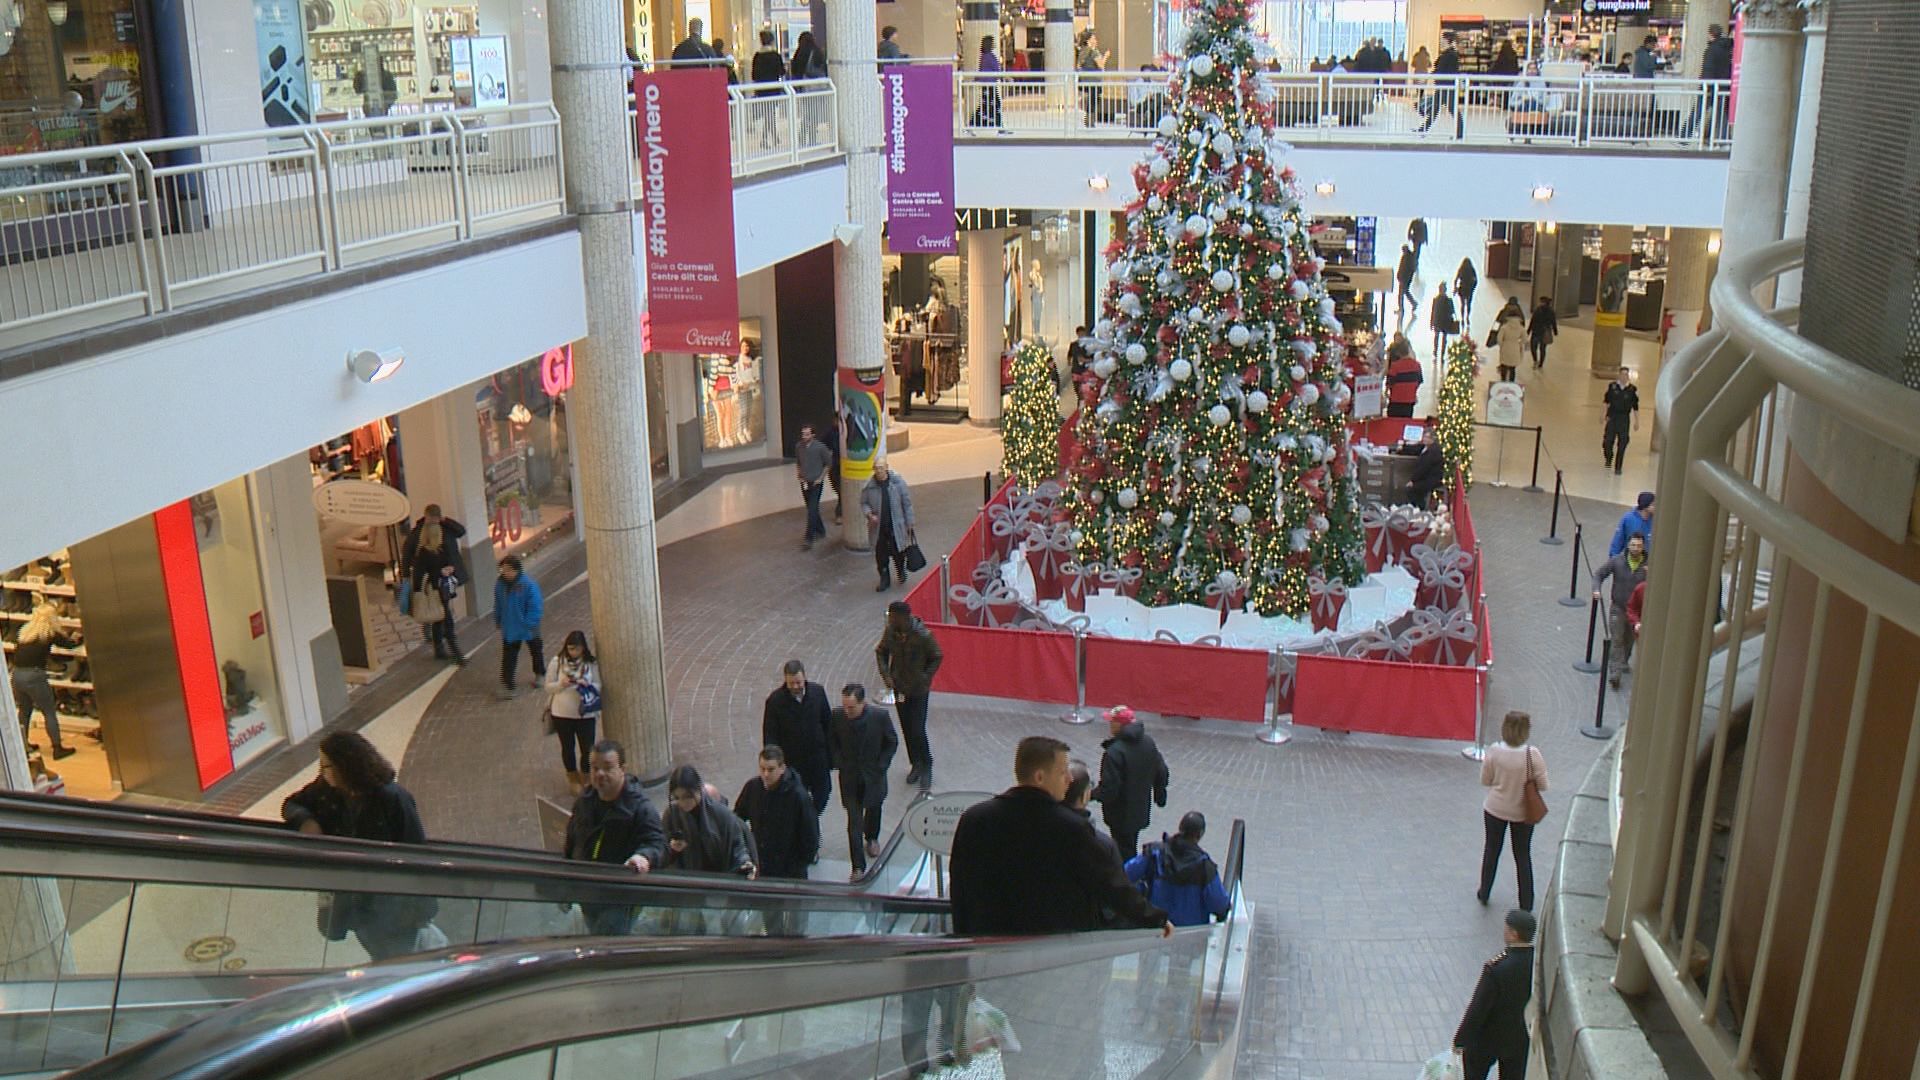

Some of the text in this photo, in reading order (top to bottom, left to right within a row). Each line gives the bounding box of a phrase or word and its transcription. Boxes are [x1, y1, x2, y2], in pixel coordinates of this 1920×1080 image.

[1597, 0, 1650, 12] sunglass hut
[105, 80, 131, 97] NIKE
[889, 74, 908, 173] #instagood
[645, 84, 668, 258] #holidayhero
[1358, 216, 1375, 227] Bell
[651, 262, 669, 271] Give
[677, 262, 714, 272] Cornwall
[651, 272, 720, 282] Centre Gift Card.
